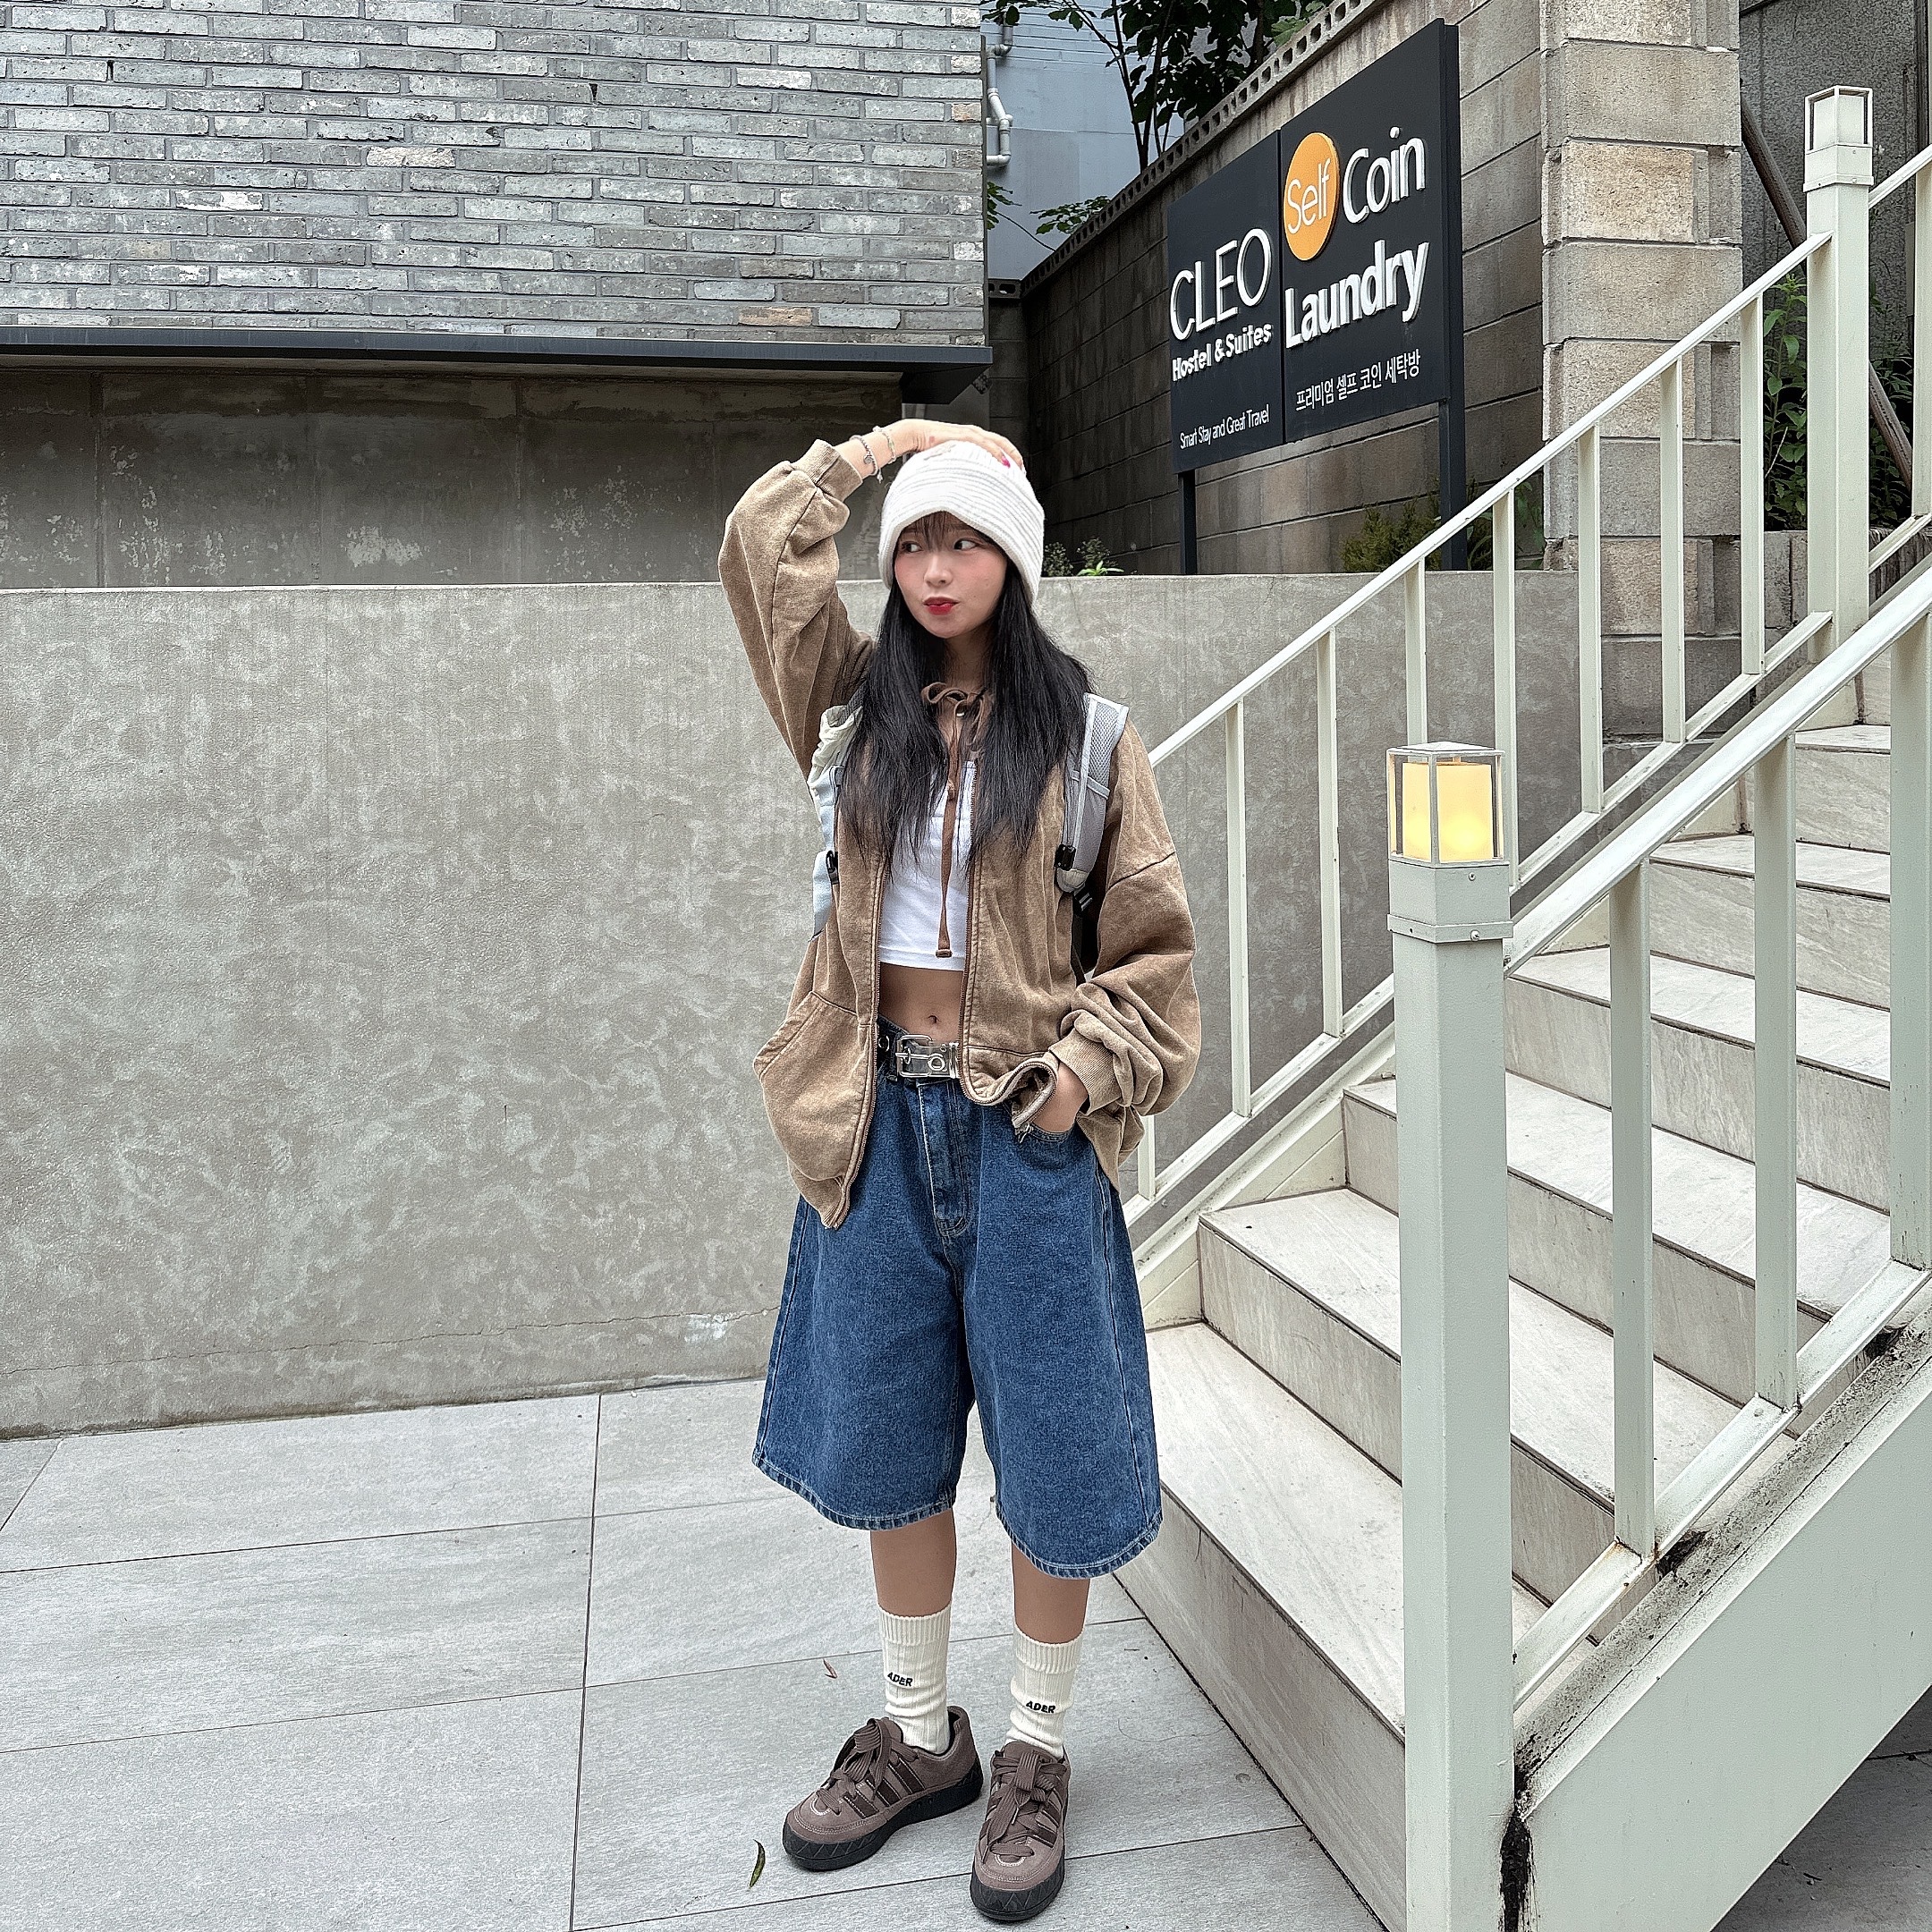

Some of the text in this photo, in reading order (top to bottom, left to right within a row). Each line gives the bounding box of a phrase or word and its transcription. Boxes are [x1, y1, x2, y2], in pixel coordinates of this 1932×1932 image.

[1286, 126, 1426, 234] Self Coin
[1169, 228, 1272, 341] CLEO
[1284, 239, 1429, 349] Laundry
[1172, 343, 1212, 381] Hostel
[1296, 348, 1421, 411] 프리미엄 셀프 코인 세탁방
[1180, 403, 1270, 449] Smart Stay and Great Travel
[886, 1672, 913, 1687] ADER
[1026, 1700, 1056, 1714] ADER
